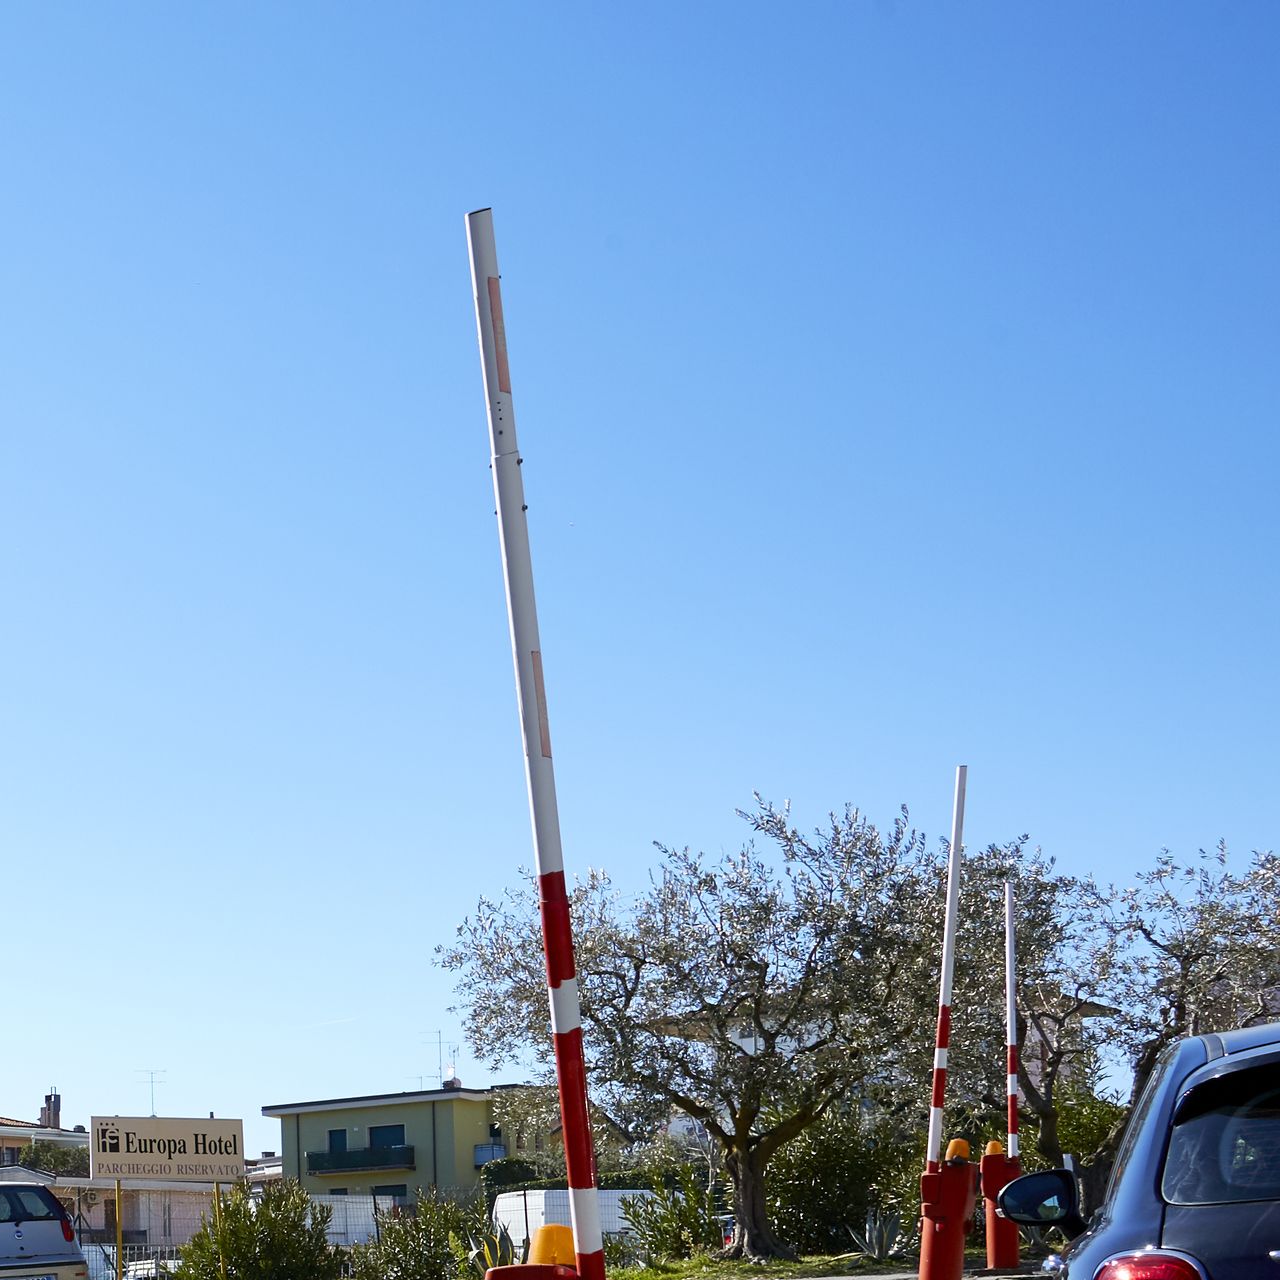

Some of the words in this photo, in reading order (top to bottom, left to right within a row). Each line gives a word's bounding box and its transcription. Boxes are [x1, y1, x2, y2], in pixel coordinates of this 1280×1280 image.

[125, 1132, 187, 1159] Europa
[193, 1133, 238, 1155] Hotel
[98, 1163, 172, 1175] PARCHEGGIO
[177, 1163, 239, 1176] RISERVATO
